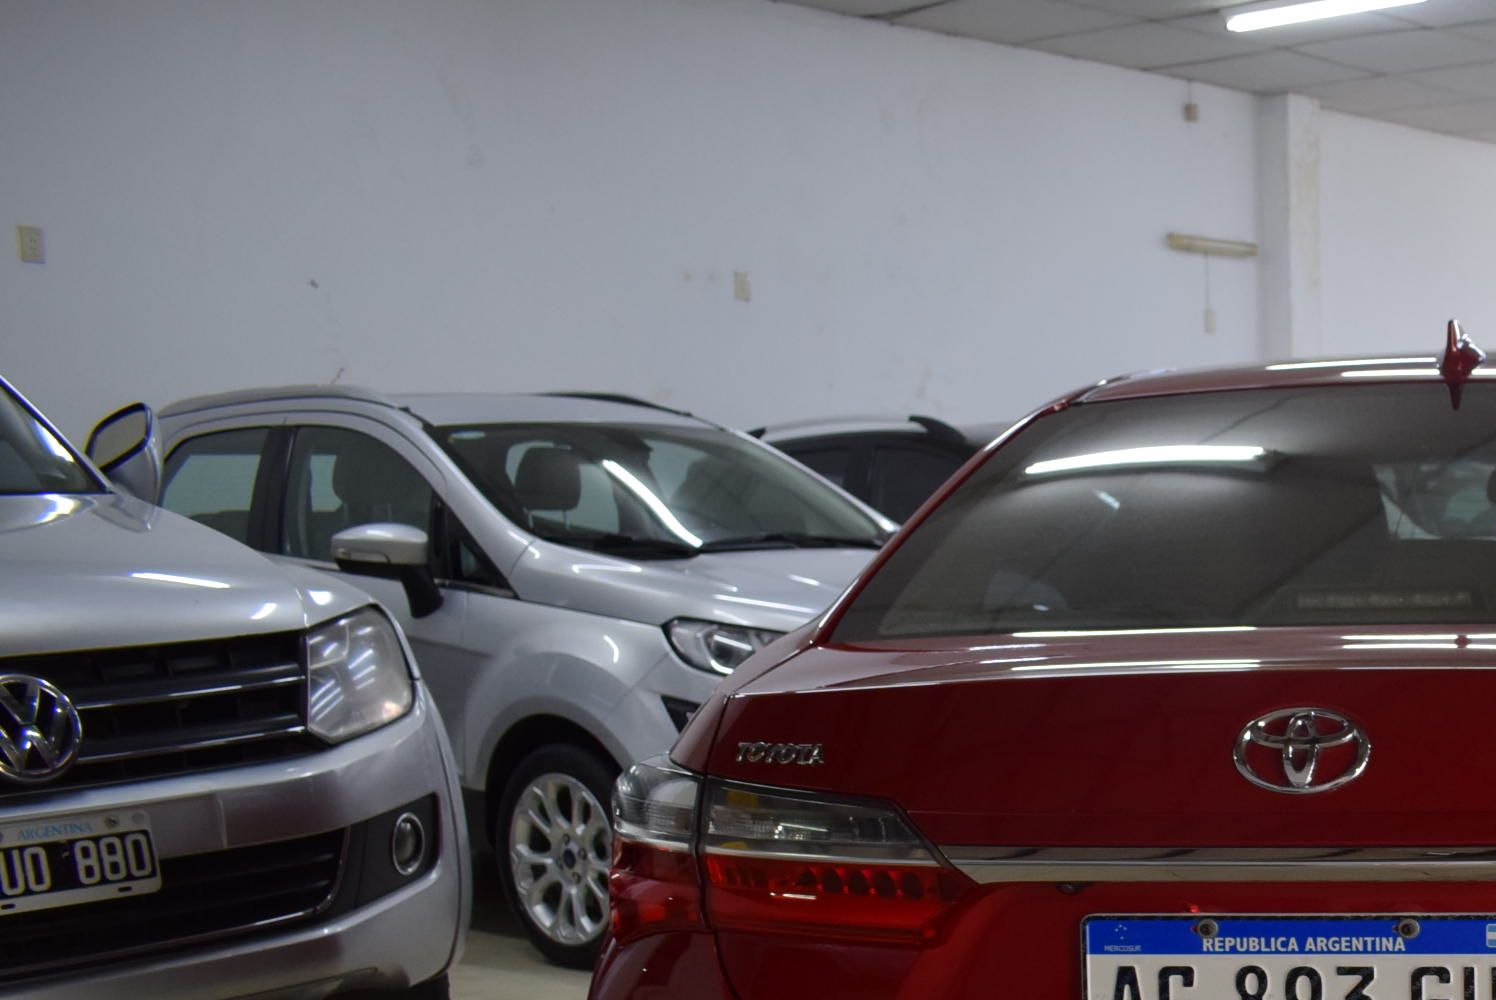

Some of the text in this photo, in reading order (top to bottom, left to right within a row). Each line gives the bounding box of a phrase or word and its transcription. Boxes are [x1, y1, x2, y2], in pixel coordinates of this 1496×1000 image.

[736, 741, 825, 765] TOYOTA
[18, 822, 92, 840] ARGENTINA
[74, 833, 152, 885] 880
[1103, 944, 1142, 952] MERCOSUR
[1202, 937, 1406, 952] REPUBLICA ARGENTINA
